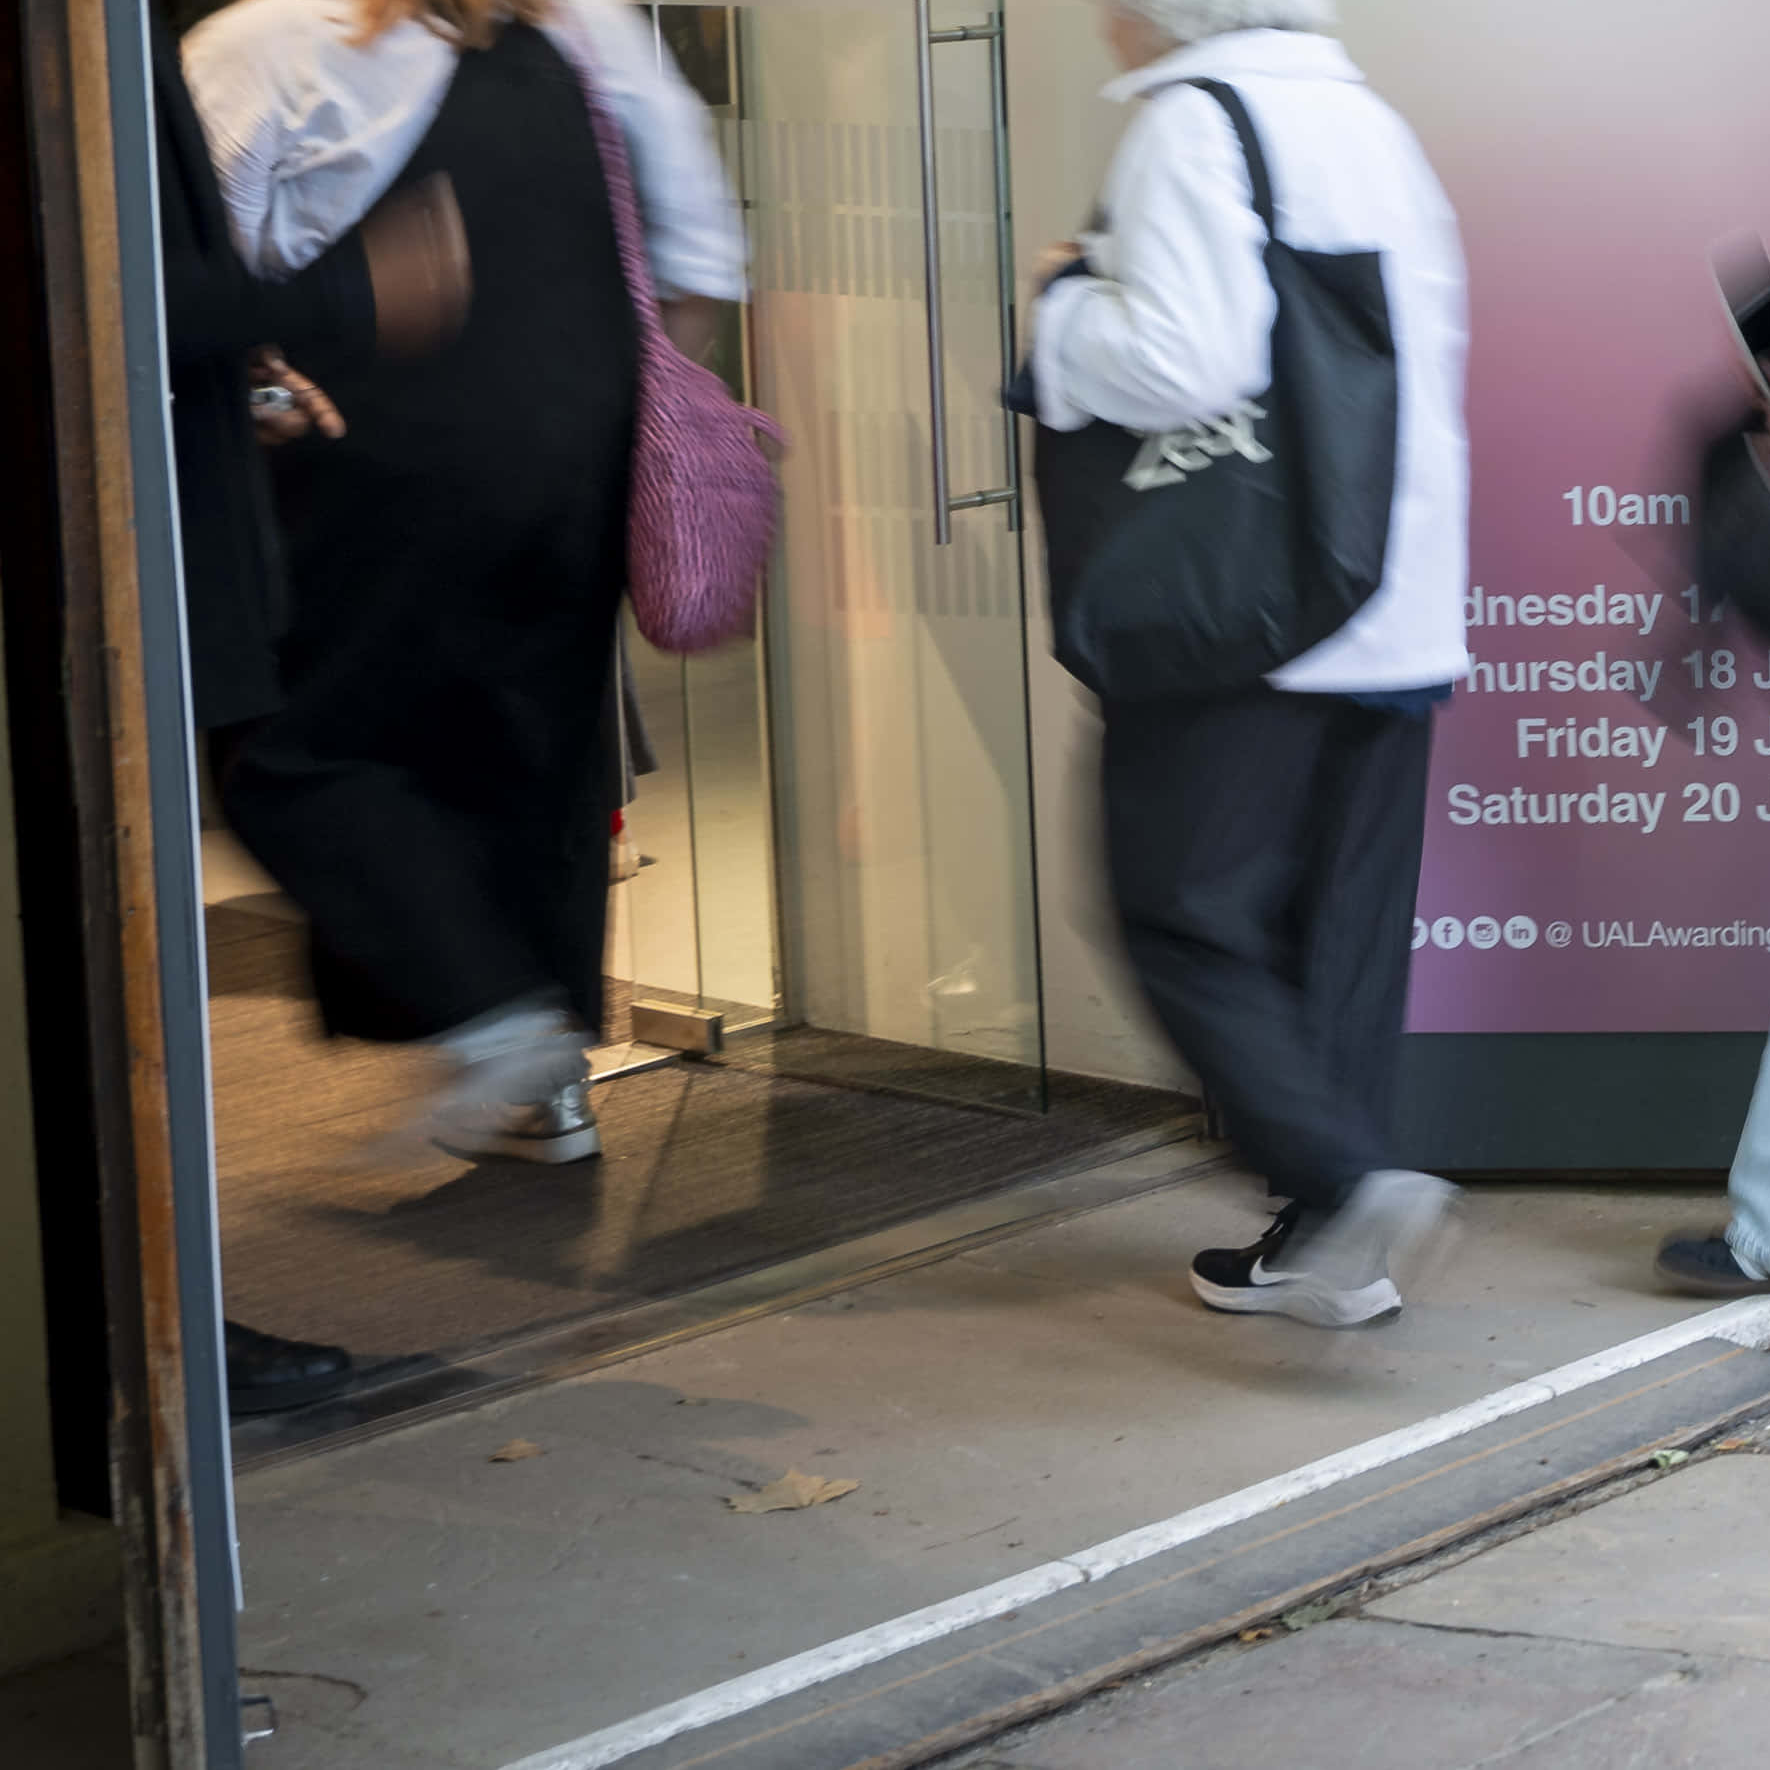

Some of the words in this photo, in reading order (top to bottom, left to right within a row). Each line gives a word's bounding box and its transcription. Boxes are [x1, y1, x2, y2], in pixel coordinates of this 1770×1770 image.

[1562, 485, 1690, 526] 10am
[1462, 584, 1663, 634] dnesday
[1466, 651, 1663, 701] hursday
[1681, 649, 1737, 690] 18
[1517, 716, 1668, 768] Friday
[1687, 716, 1739, 757] 19
[1447, 783, 1667, 834] Saturday
[1682, 782, 1741, 823] 20
[1545, 920, 1573, 949] @
